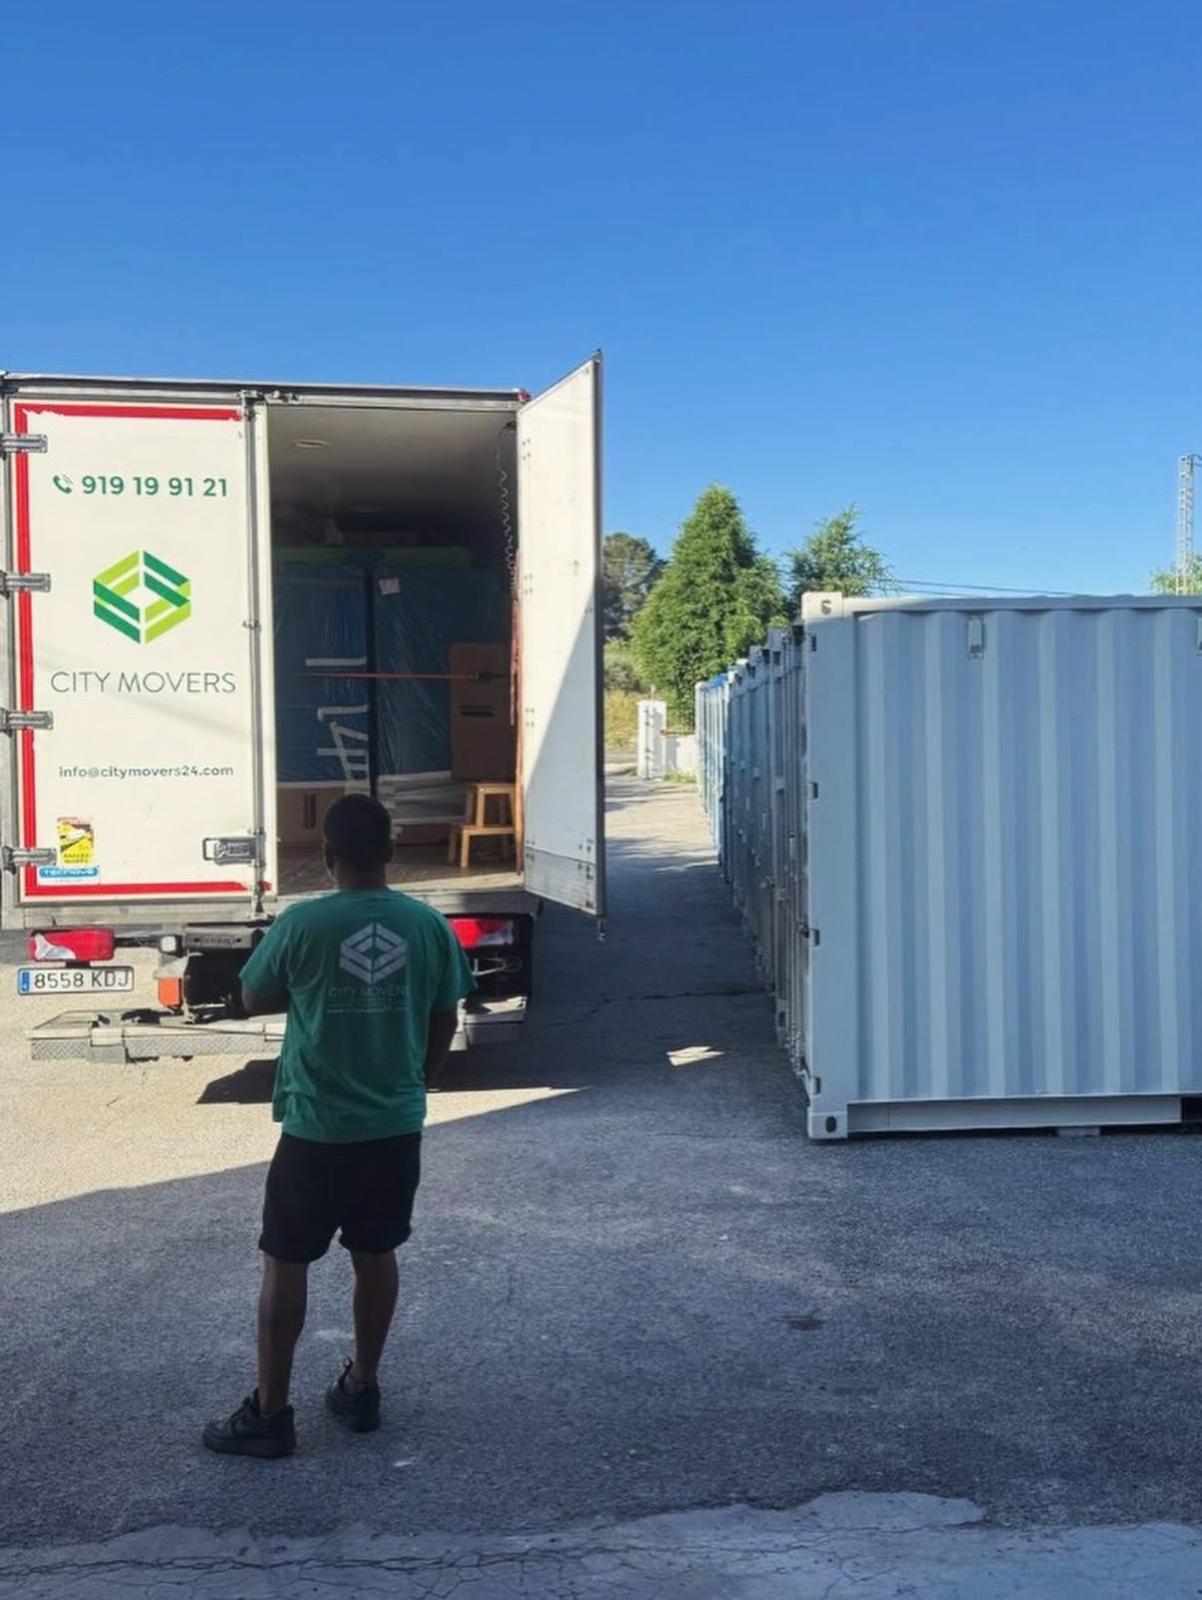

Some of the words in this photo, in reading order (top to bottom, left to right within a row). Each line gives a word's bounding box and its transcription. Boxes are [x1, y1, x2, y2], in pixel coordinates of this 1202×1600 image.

[81, 475, 124, 495] 919
[133, 476, 159, 496] 19
[168, 477, 193, 497] 91
[203, 478, 227, 497] 21
[50, 671, 111, 693] CITY
[117, 672, 236, 694] MOVERS
[58, 764, 235, 780] info@citymovers24.com
[34, 971, 84, 989] 8558
[91, 969, 129, 988] KDJ
